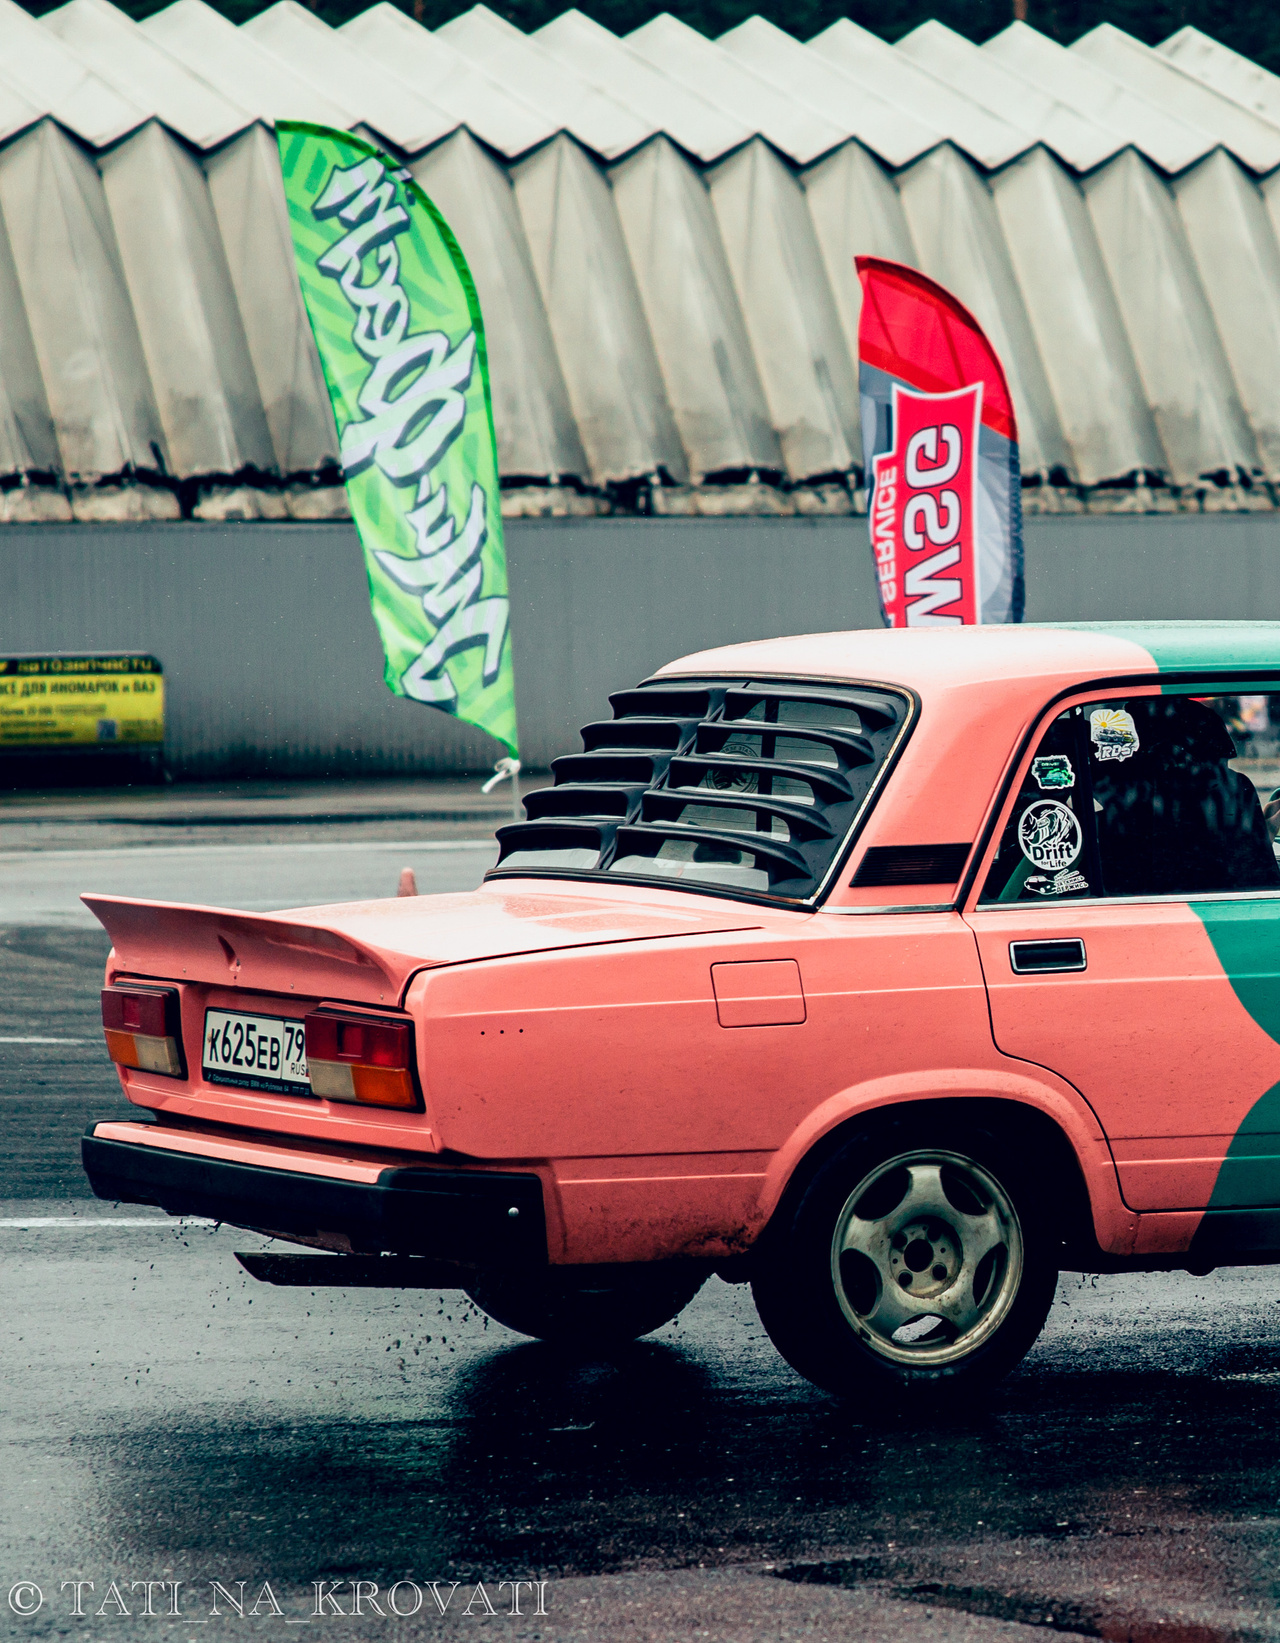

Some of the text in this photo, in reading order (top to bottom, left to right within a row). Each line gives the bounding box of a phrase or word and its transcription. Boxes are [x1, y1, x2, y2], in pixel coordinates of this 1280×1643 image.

[1102, 743, 1132, 758] RDS
[1032, 843, 1073, 860] Drift
[1049, 860, 1067, 868] Life
[290, 1062, 305, 1076] RUS
